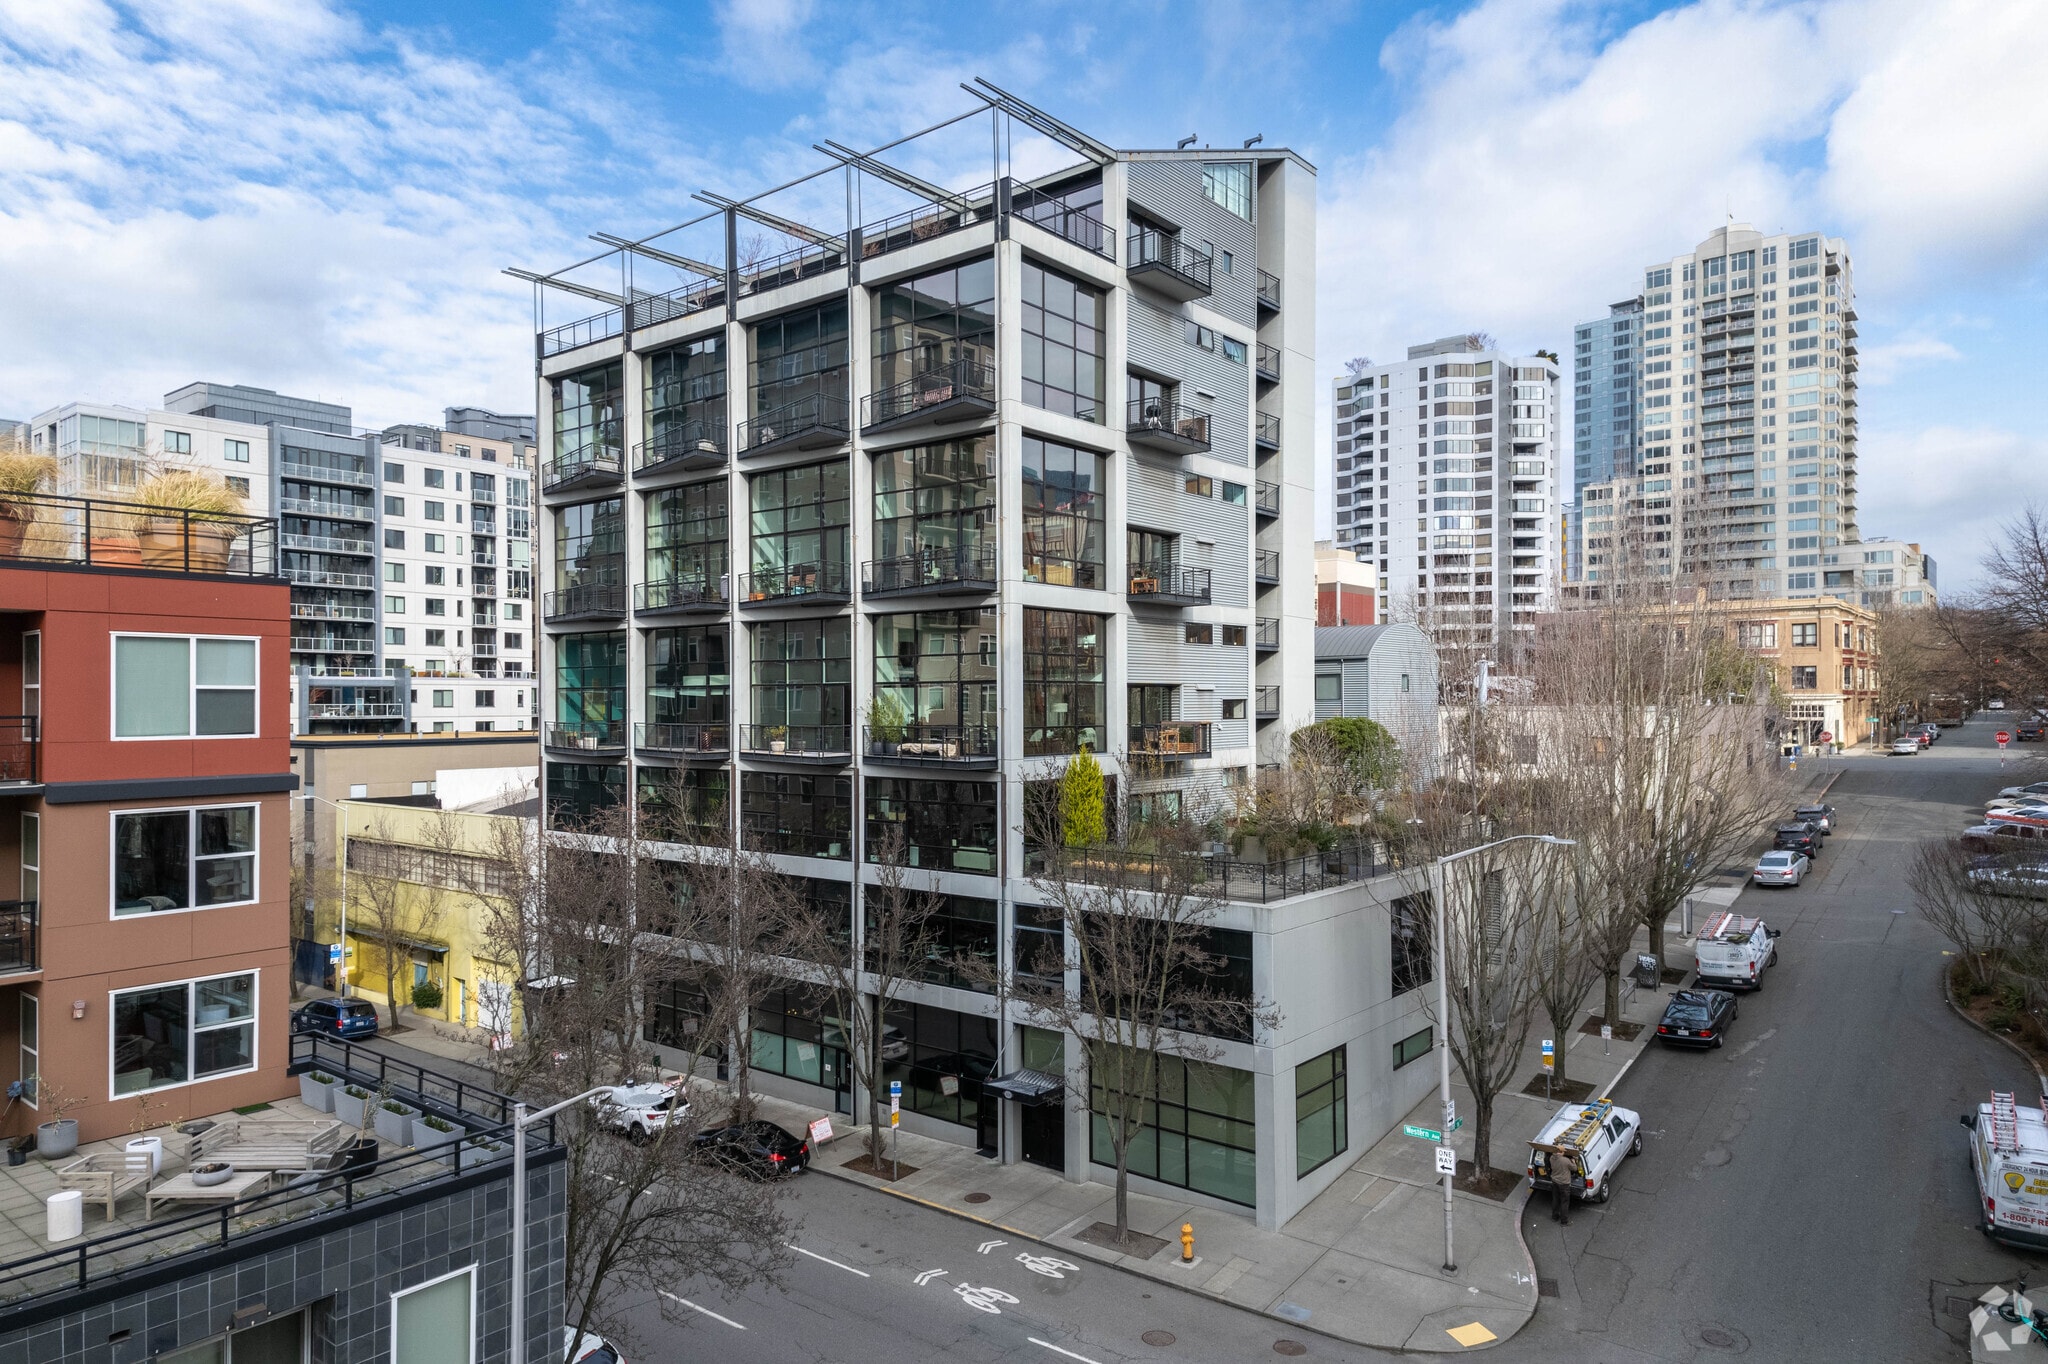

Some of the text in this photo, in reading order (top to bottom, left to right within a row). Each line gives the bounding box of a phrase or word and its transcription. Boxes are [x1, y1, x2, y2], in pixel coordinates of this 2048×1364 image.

[1405, 1126, 1430, 1138] Western
[1438, 1150, 1452, 1158] ONE
[1438, 1157, 1453, 1165] WAY
[2025, 1185, 2048, 1196] ELEC
[2018, 1206, 2048, 1216] 206-720-
